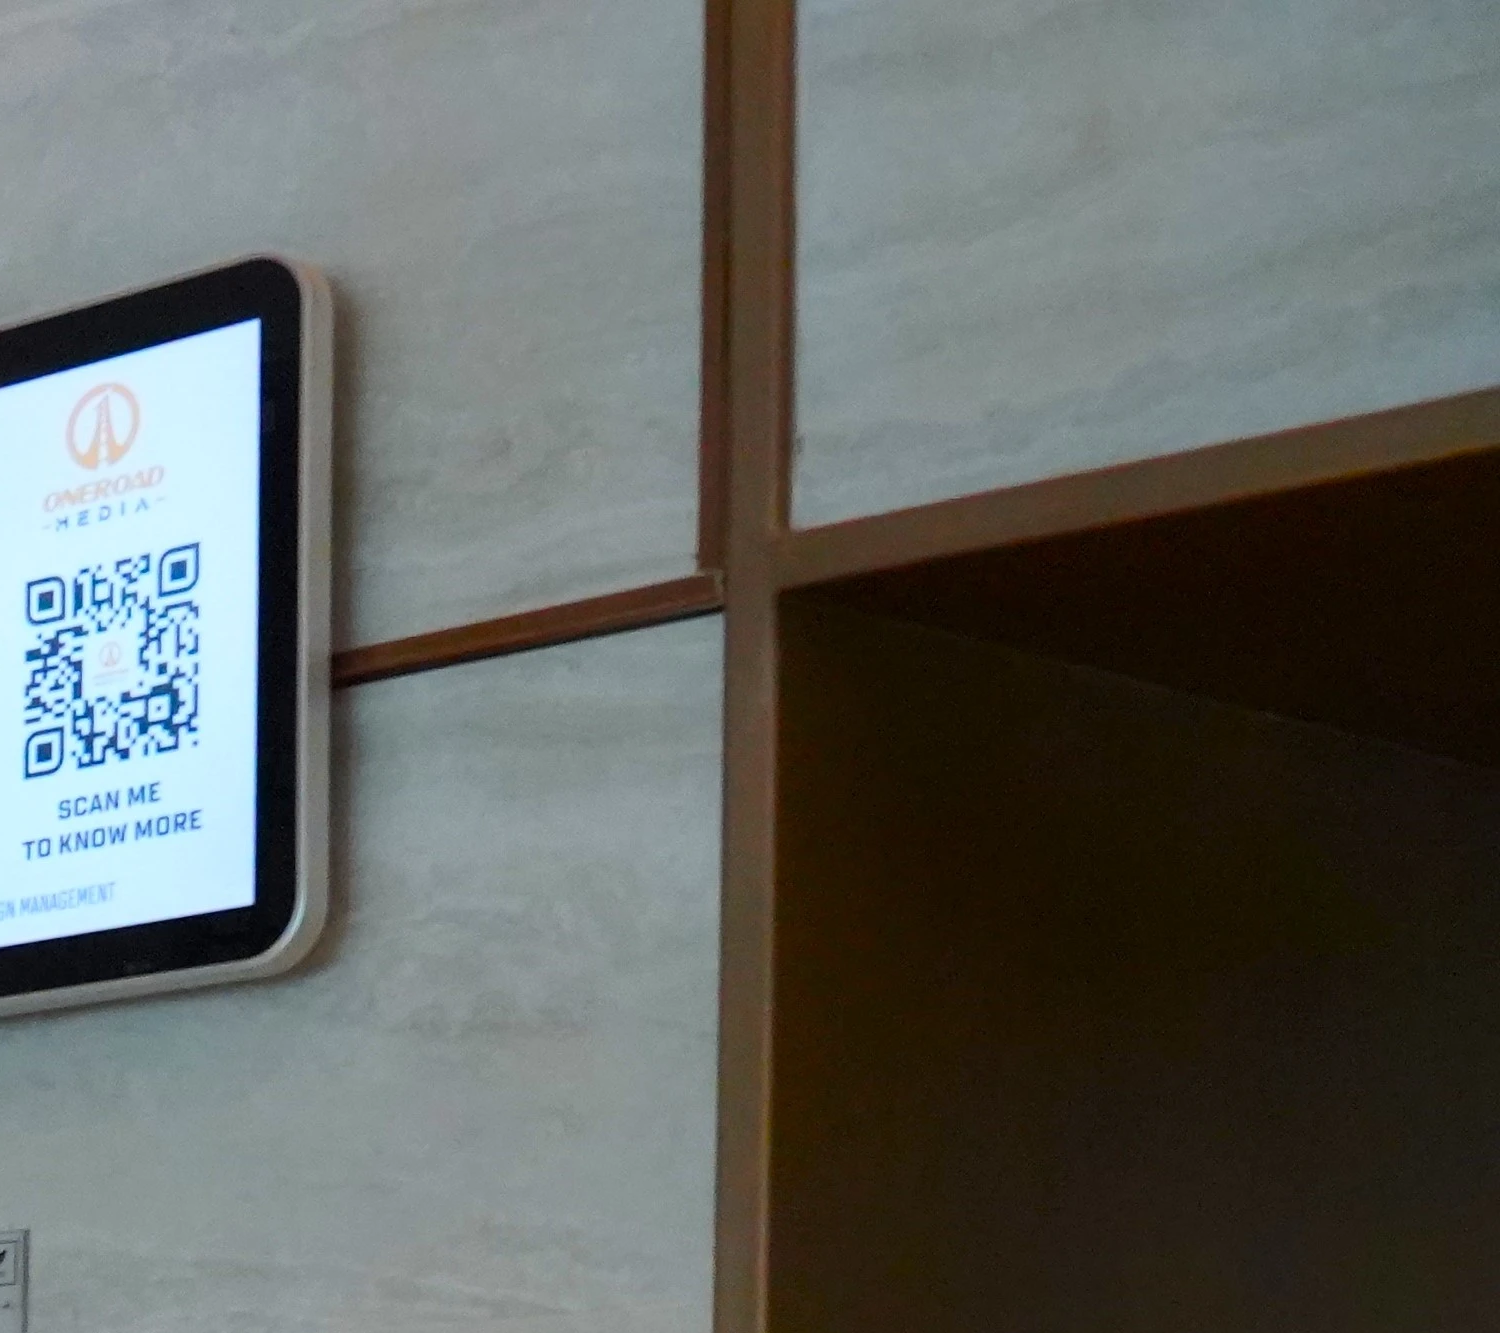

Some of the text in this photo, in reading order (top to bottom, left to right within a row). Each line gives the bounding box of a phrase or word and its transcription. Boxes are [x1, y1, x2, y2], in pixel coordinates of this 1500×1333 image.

[58, 781, 161, 820] SCAN ME
[22, 809, 202, 860] TO KNOW MORE
[19, 881, 117, 918] MANAGEMENT
